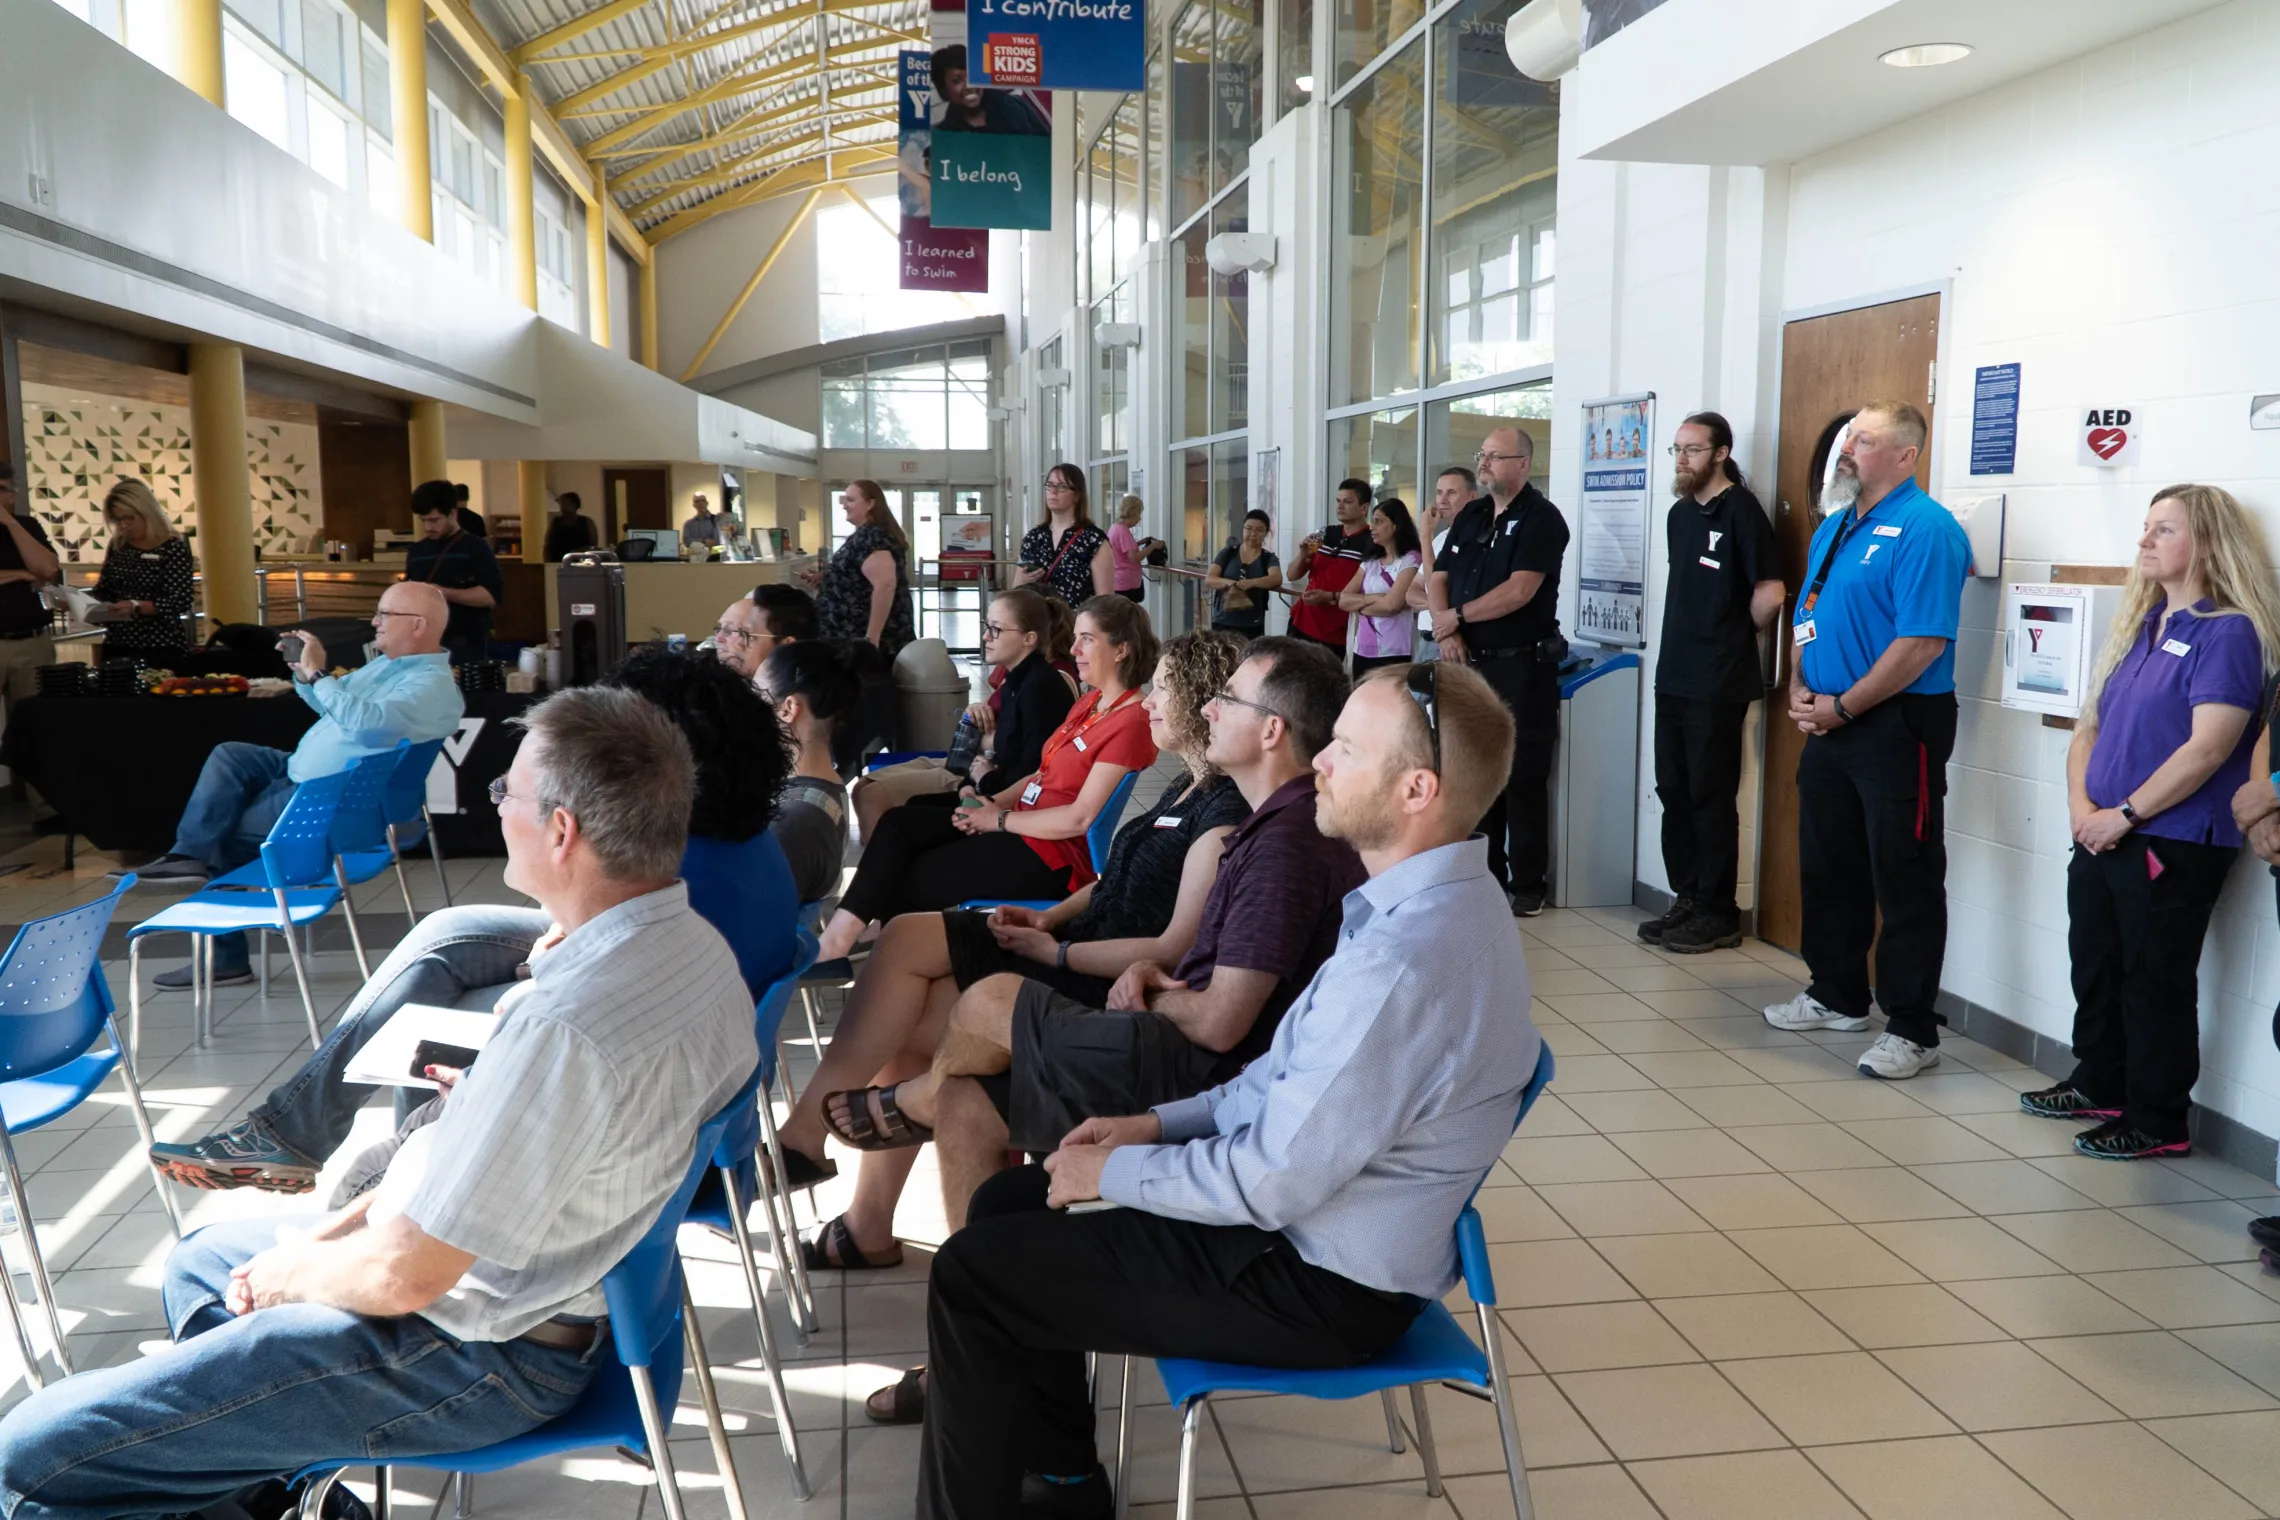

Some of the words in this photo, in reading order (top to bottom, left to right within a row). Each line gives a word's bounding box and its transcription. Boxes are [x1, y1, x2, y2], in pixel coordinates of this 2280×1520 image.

[981, 0, 995, 13] I
[1001, 0, 1133, 21] contribute
[1011, 36, 1036, 46] YMCA
[993, 45, 1037, 57] STRONG
[906, 56, 931, 70] Beca
[993, 56, 1037, 74] KIDS
[906, 73, 919, 86] of
[994, 73, 1037, 84] CAMPAIGN
[940, 159, 951, 181] I
[956, 160, 1022, 192] belong
[904, 239, 914, 256] I
[917, 243, 976, 259] learned
[904, 261, 920, 277] to
[923, 264, 957, 278] swim
[2085, 409, 2132, 426] AED
[1626, 472, 1646, 486] POLICY
